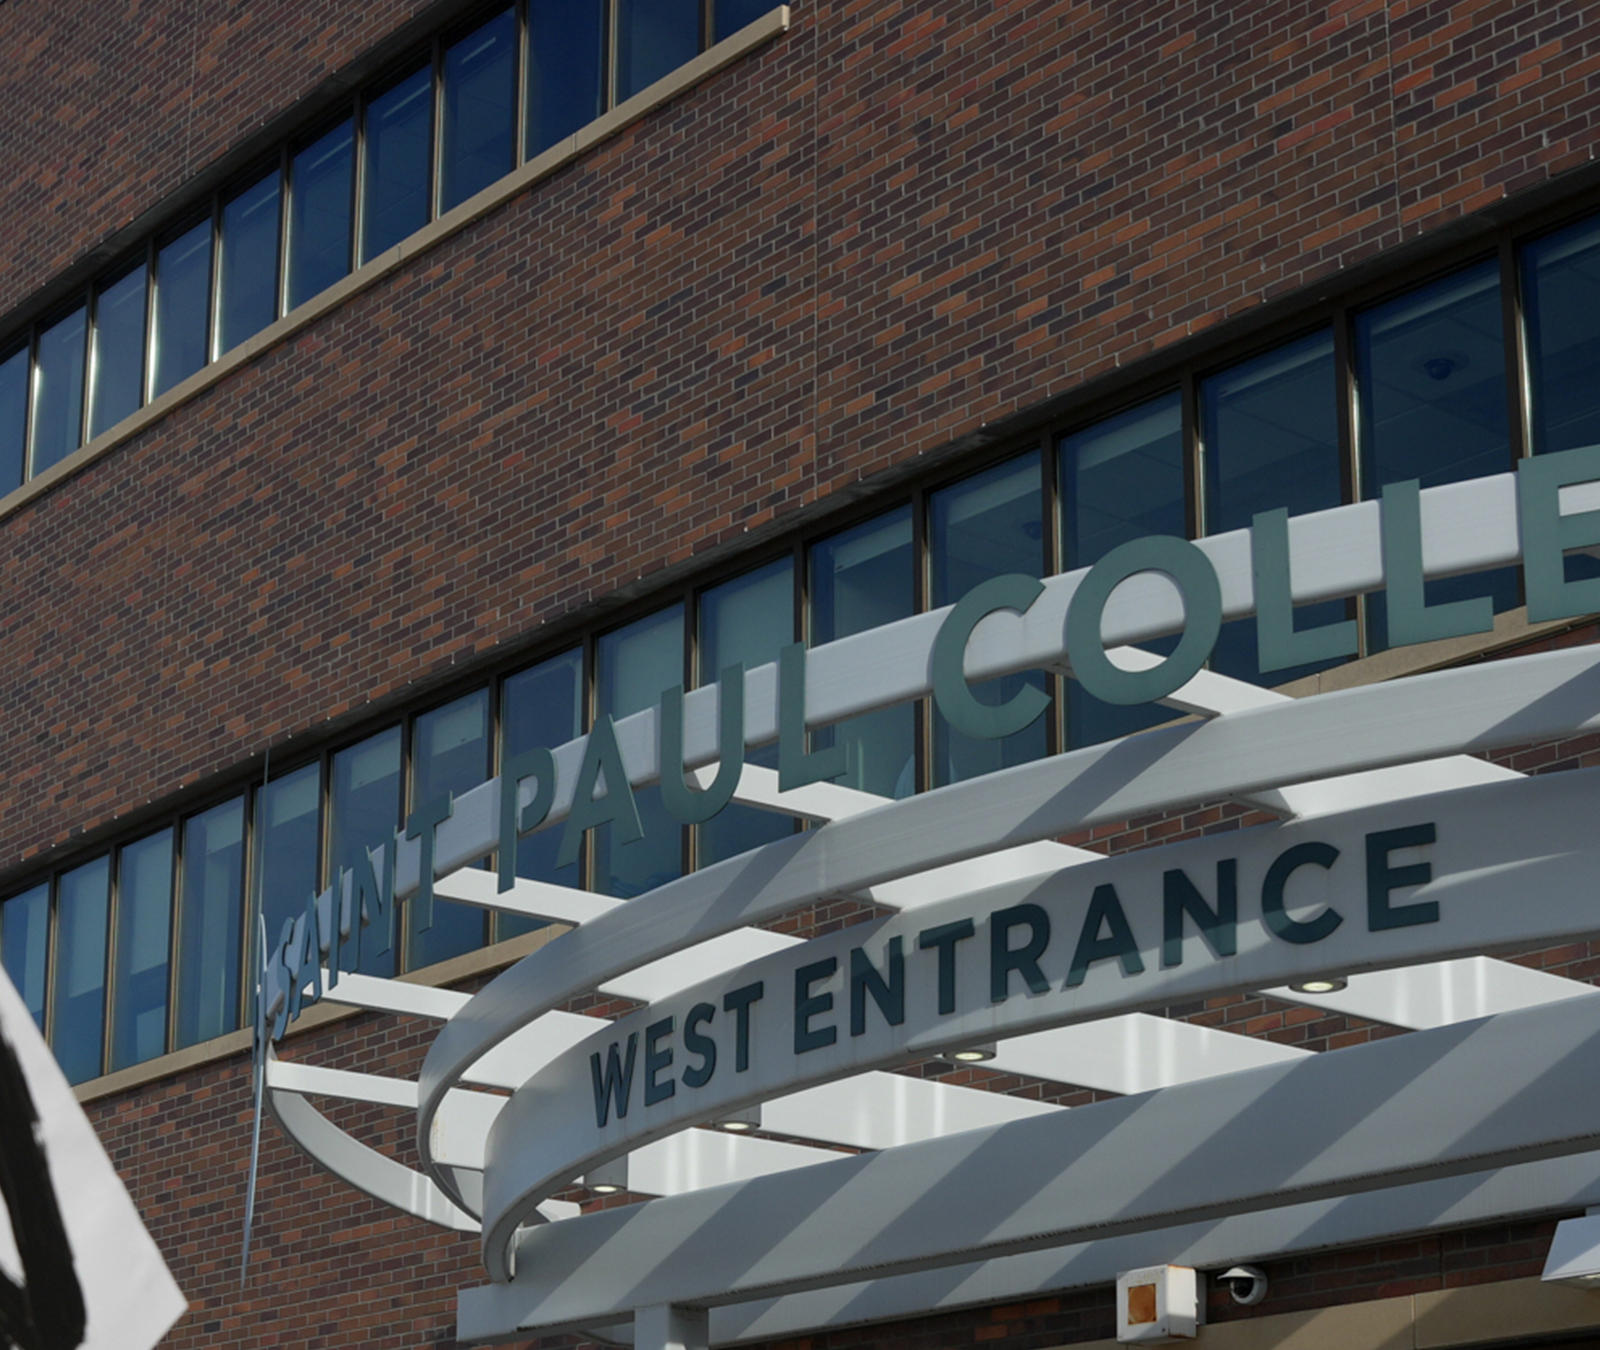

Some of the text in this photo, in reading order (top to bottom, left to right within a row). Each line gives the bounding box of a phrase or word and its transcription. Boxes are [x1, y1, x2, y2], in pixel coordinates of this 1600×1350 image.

[272, 790, 454, 1042] SAINT
[497, 640, 848, 895] PAUL
[590, 821, 1441, 1129] WEST ENTRANCE
